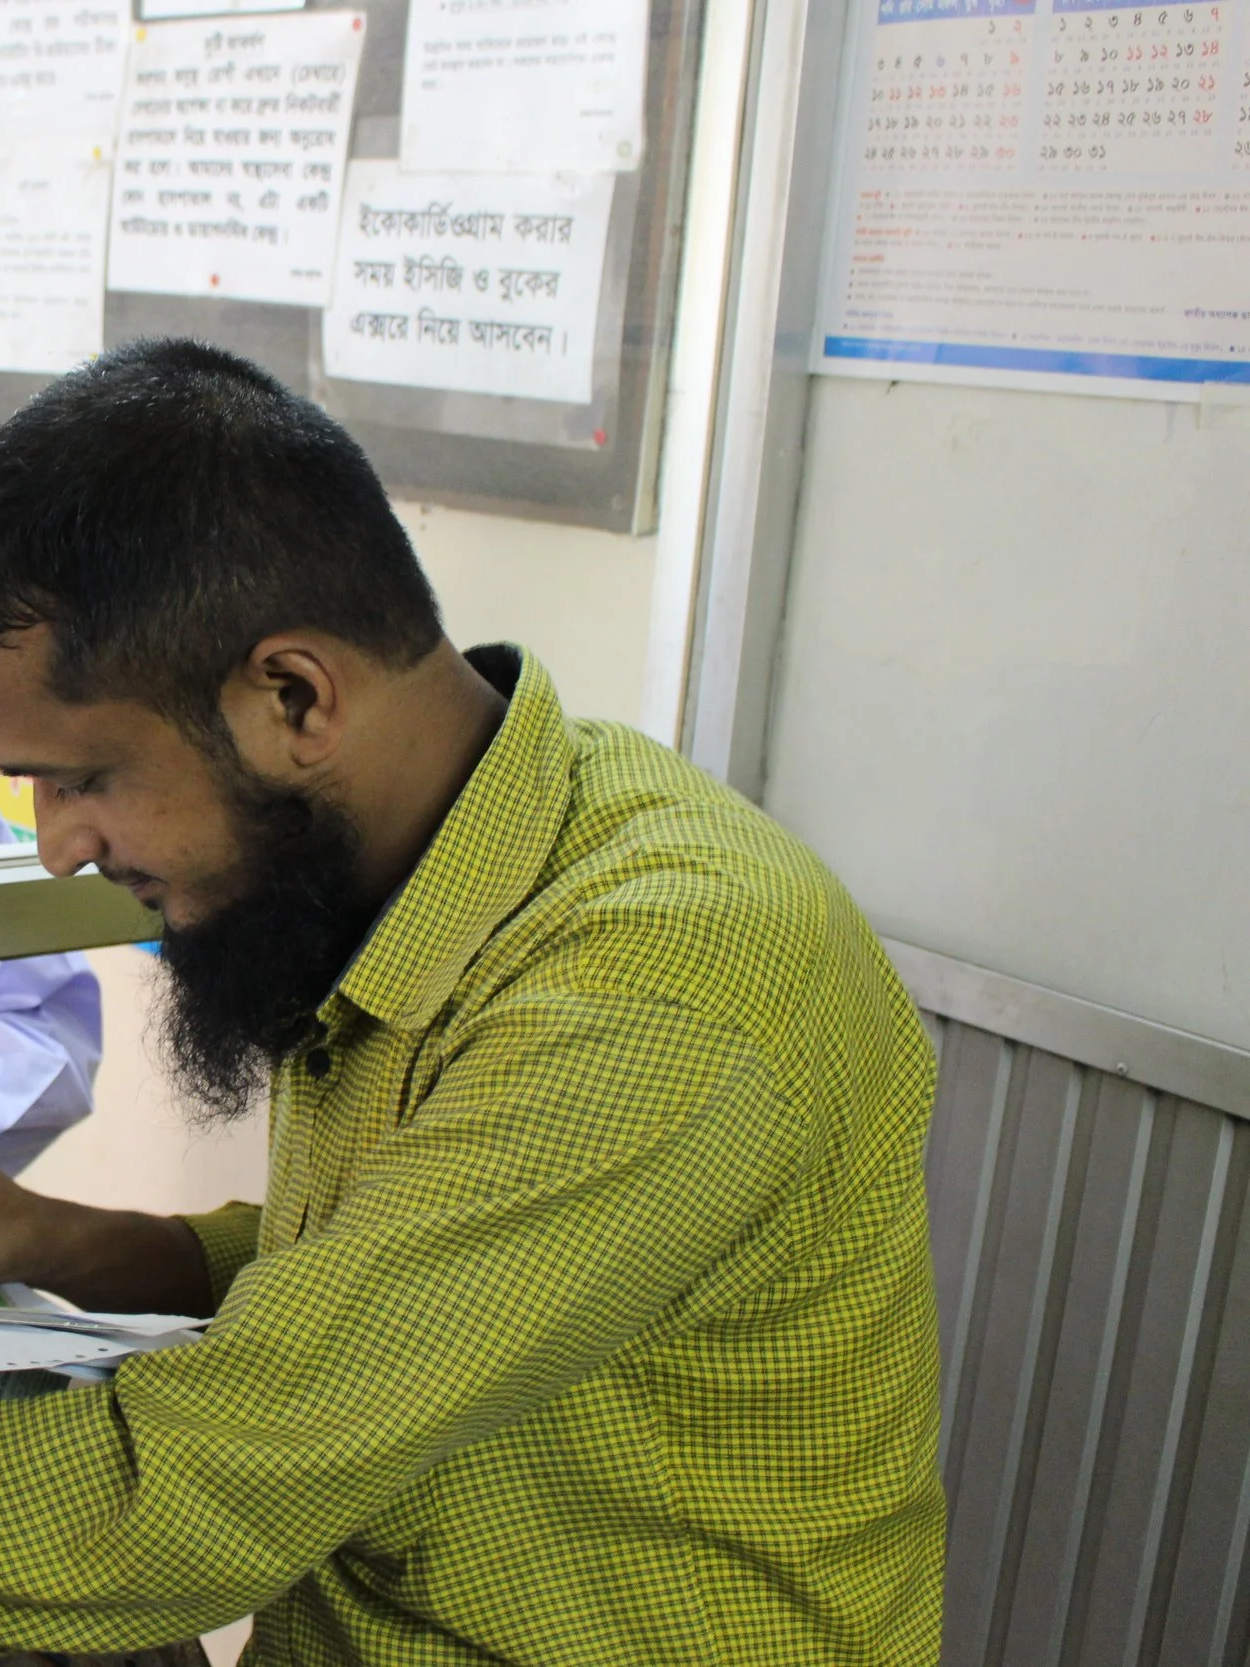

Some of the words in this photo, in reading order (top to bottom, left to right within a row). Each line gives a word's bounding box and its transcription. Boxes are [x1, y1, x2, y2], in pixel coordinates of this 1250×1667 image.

[1060, 18, 1067, 31] ১
[1084, 16, 1093, 31] ২
[1109, 15, 1118, 28] ৩
[1134, 13, 1142, 26] ৪
[1158, 10, 1168, 25] ৫
[1184, 9, 1194, 23] ৬
[1210, 7, 1219, 22] ৭
[1054, 50, 1064, 63] ৮
[1080, 49, 1090, 63] ৯
[1101, 47, 1118, 62] ১০
[1126, 46, 1143, 61] ১১
[1151, 44, 1168, 60] ১২
[1176, 43, 1195, 58] ১৩
[1201, 40, 1219, 56] ১৪
[1047, 81, 1065, 96] ১৫
[1072, 81, 1090, 95] ১৬
[1097, 79, 1114, 95] ১৭
[1122, 78, 1139, 93] ১৮
[1146, 77, 1165, 93] ১৯
[1171, 76, 1190, 91] ২০
[1198, 74, 1215, 90] ২১
[868, 117, 881, 132] ১৭
[885, 117, 898, 130] ১৮
[904, 115, 919, 129] ১৯
[926, 115, 942, 130] ২০
[949, 115, 965, 129] ২১
[974, 114, 991, 129] ২২
[999, 115, 1019, 128] ২৩
[1043, 113, 1061, 128] ২২
[1068, 113, 1086, 127] ২৩
[1092, 112, 1110, 127] ২৪
[1118, 111, 1135, 126] ২৫
[1142, 110, 1161, 125] ২৬
[1167, 110, 1186, 125] ২৭
[1193, 108, 1213, 124] ২৮
[1039, 145, 1057, 159] ২৯
[1063, 145, 1082, 158] ৩০
[1088, 143, 1106, 158] ৩১
[514, 212, 574, 243] করার
[354, 259, 395, 289] সময়
[403, 253, 464, 292] ইসিজি
[473, 269, 489, 292] ও
[498, 267, 560, 303] বুকের
[351, 310, 409, 342] এক্সরে
[418, 307, 460, 345] নিয়ে
